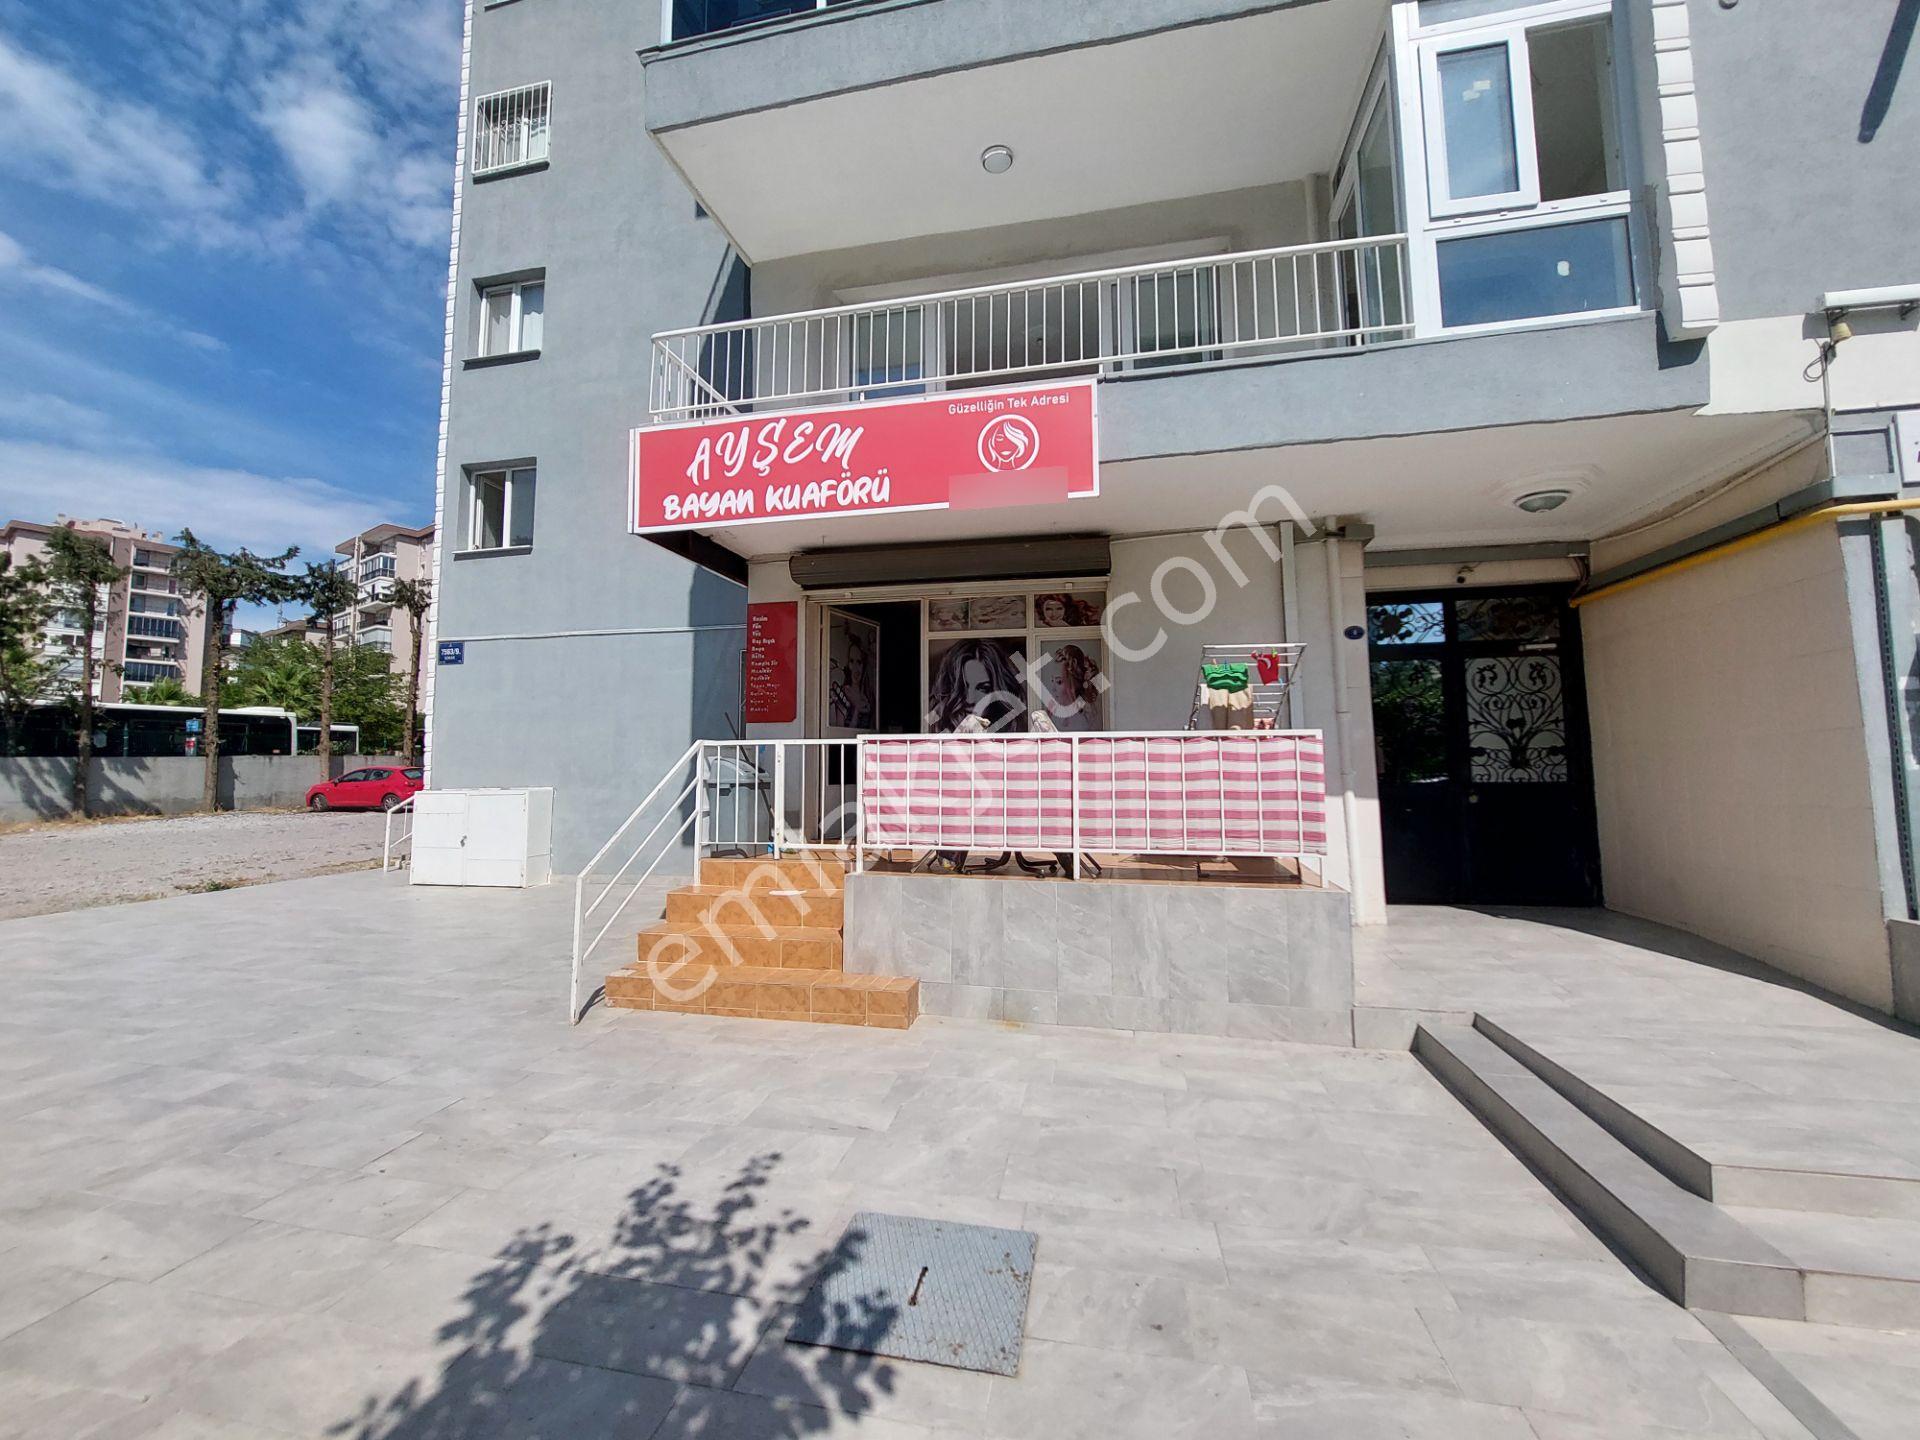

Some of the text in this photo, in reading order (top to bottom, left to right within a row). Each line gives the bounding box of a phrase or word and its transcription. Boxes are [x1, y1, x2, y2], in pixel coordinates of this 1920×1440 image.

[948, 392, 1070, 415] Güzelliğin Tek Adresi
[686, 418, 864, 486] AYŞEM
[663, 468, 891, 521] BAYAN KUAFÖRÜ
